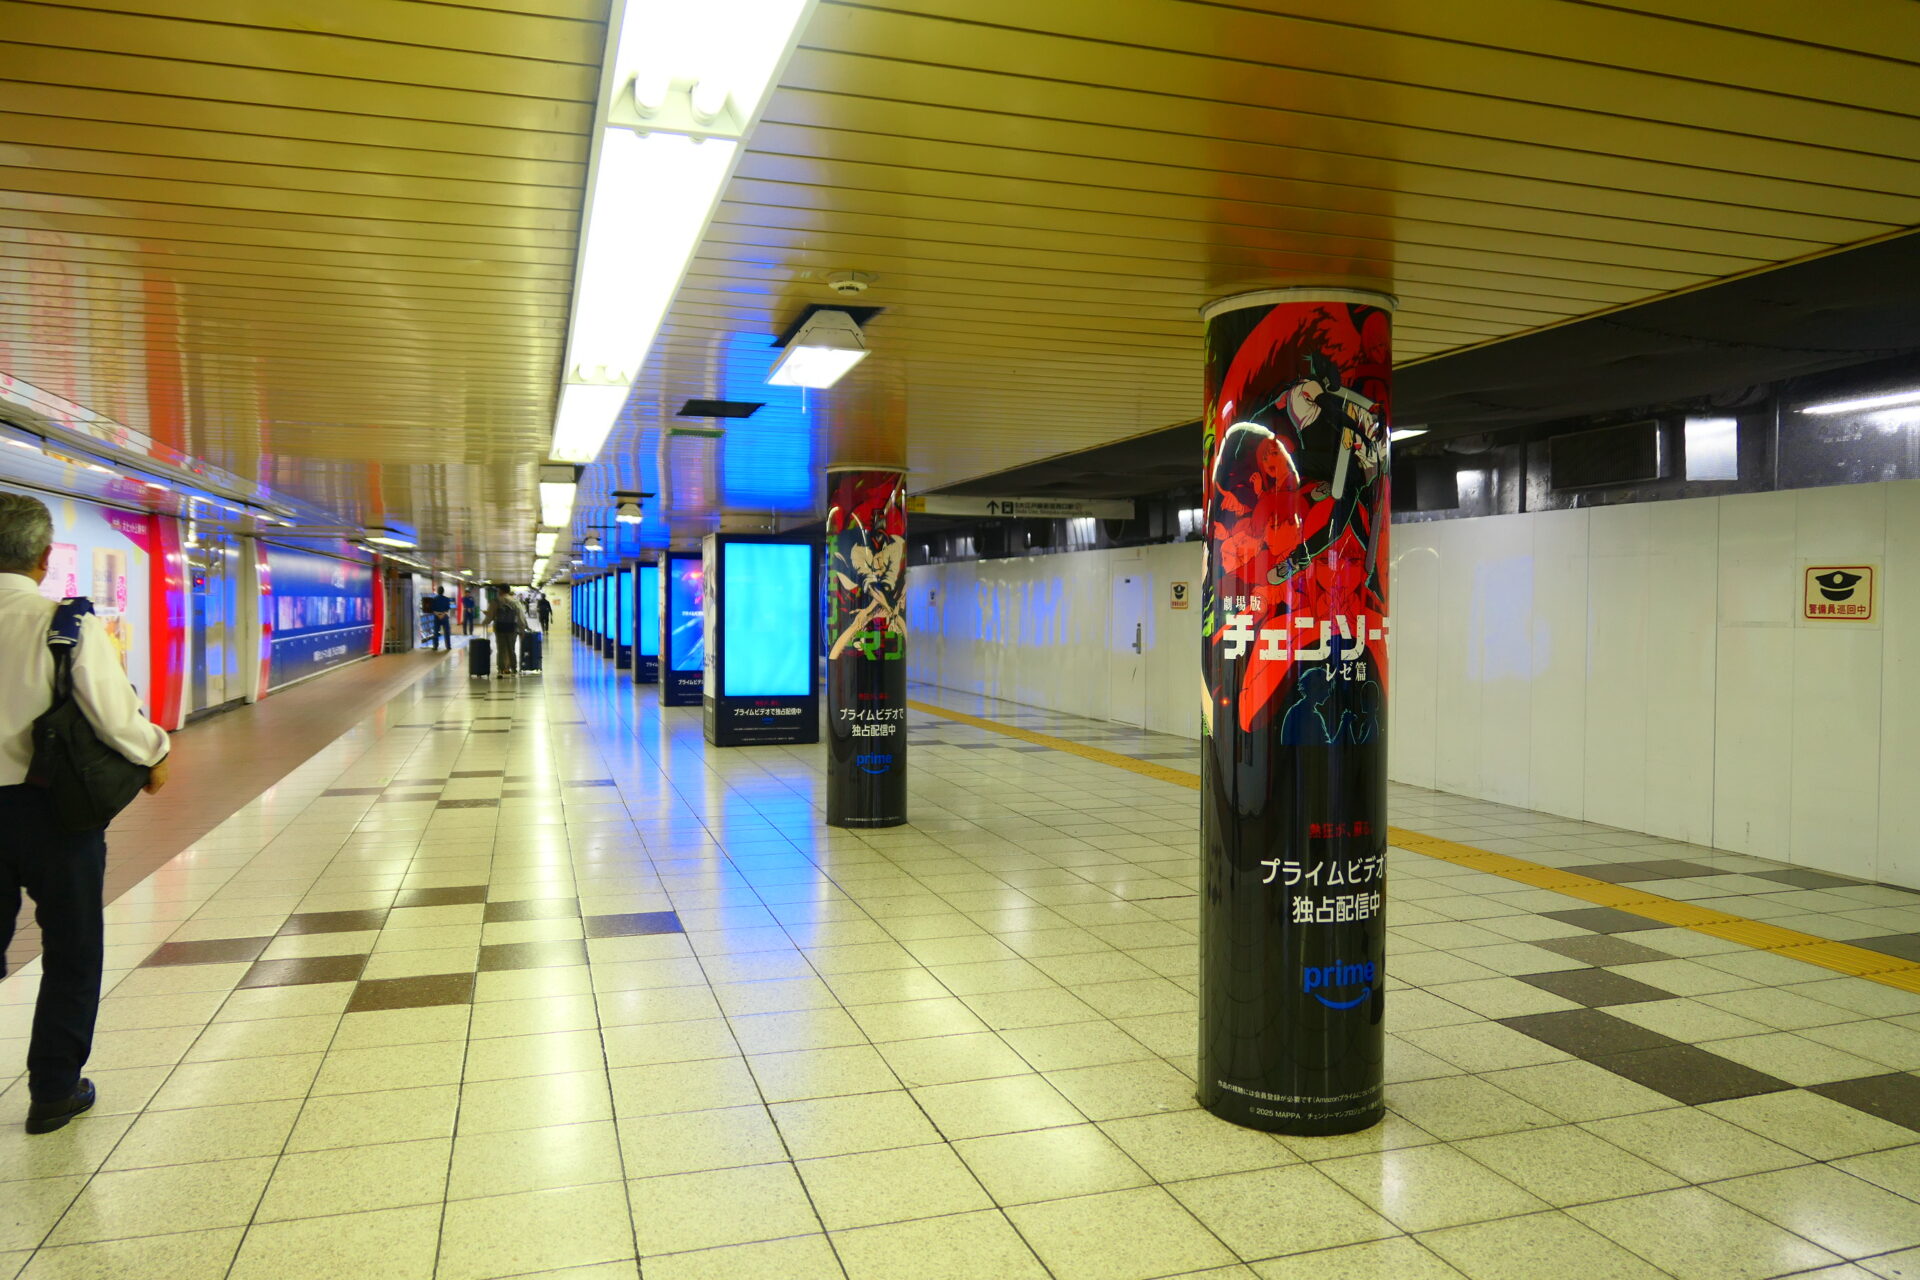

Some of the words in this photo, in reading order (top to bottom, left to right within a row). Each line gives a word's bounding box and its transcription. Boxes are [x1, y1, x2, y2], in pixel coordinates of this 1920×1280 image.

[1223, 595, 1262, 612] 劇場版
[1808, 604, 1866, 615] 警備員巡回中
[1325, 662, 1367, 682] レゼ篇
[733, 707, 802, 716] プライムビデオで独占配信中
[840, 707, 904, 721] プライムビデオで
[852, 723, 896, 737] 独占配信中
[856, 751, 893, 767] prime
[1292, 890, 1380, 924] 独占配信中
[1303, 959, 1375, 994] prime
[1256, 1107, 1274, 1117] 2025
